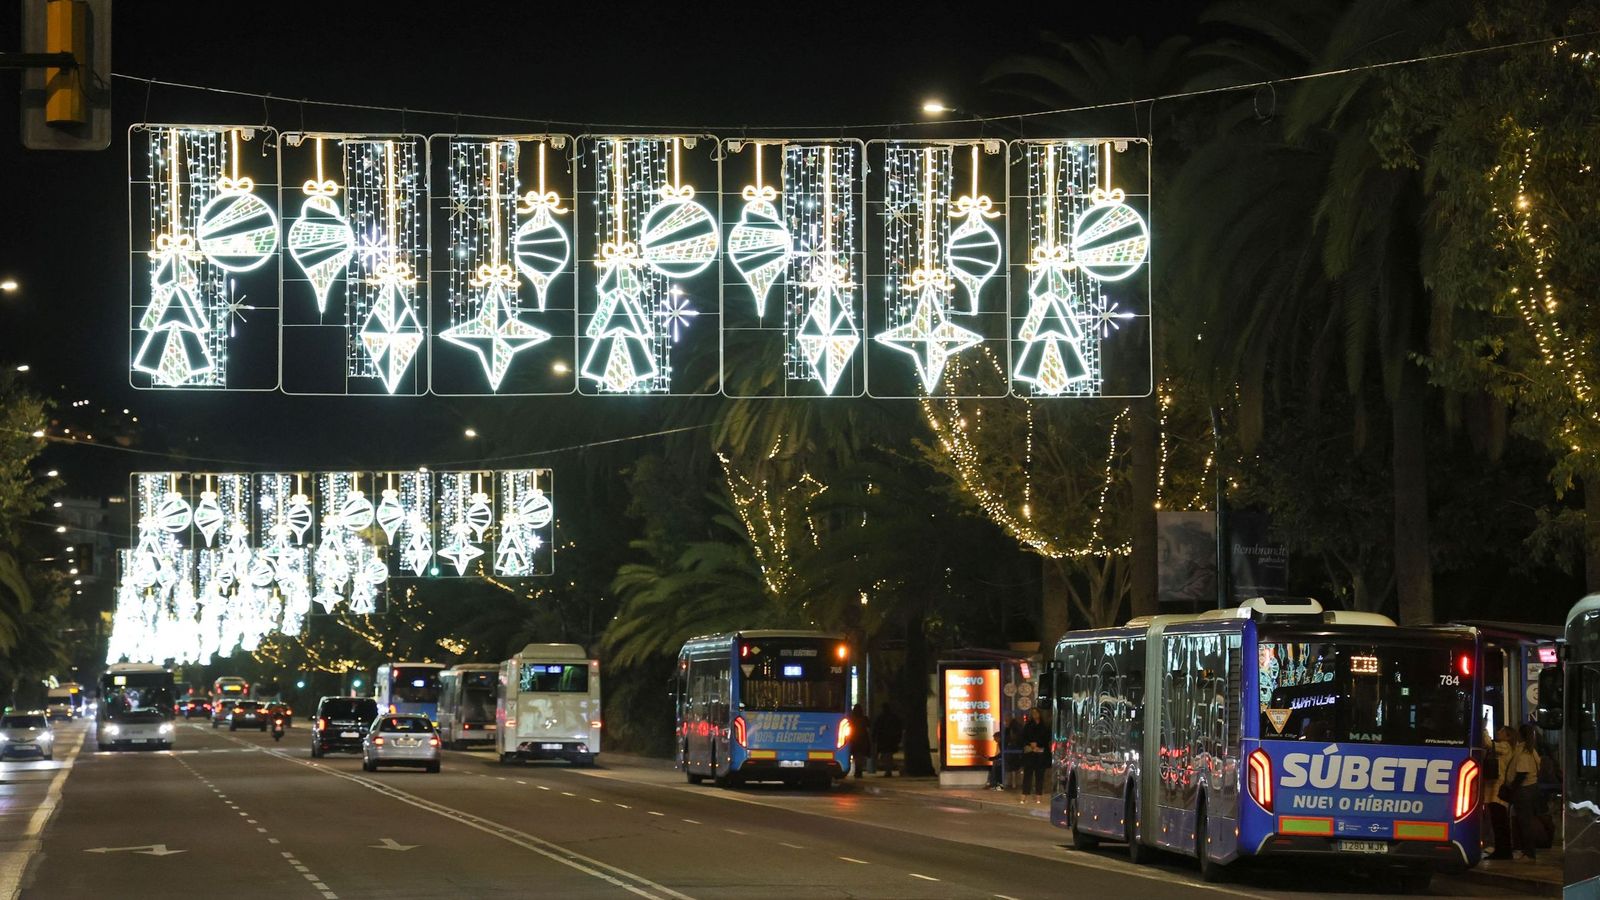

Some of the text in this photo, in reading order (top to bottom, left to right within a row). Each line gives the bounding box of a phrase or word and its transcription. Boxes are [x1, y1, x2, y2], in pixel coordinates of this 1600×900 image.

[1440, 675, 1460, 686] 784
[756, 711, 801, 731] SÚBETE
[776, 730, 816, 743] ELÉCTRICO
[1349, 732, 1383, 741] MAN
[1280, 743, 1453, 794] SÚBETE
[1353, 795, 1424, 814] HÍBRIDO
